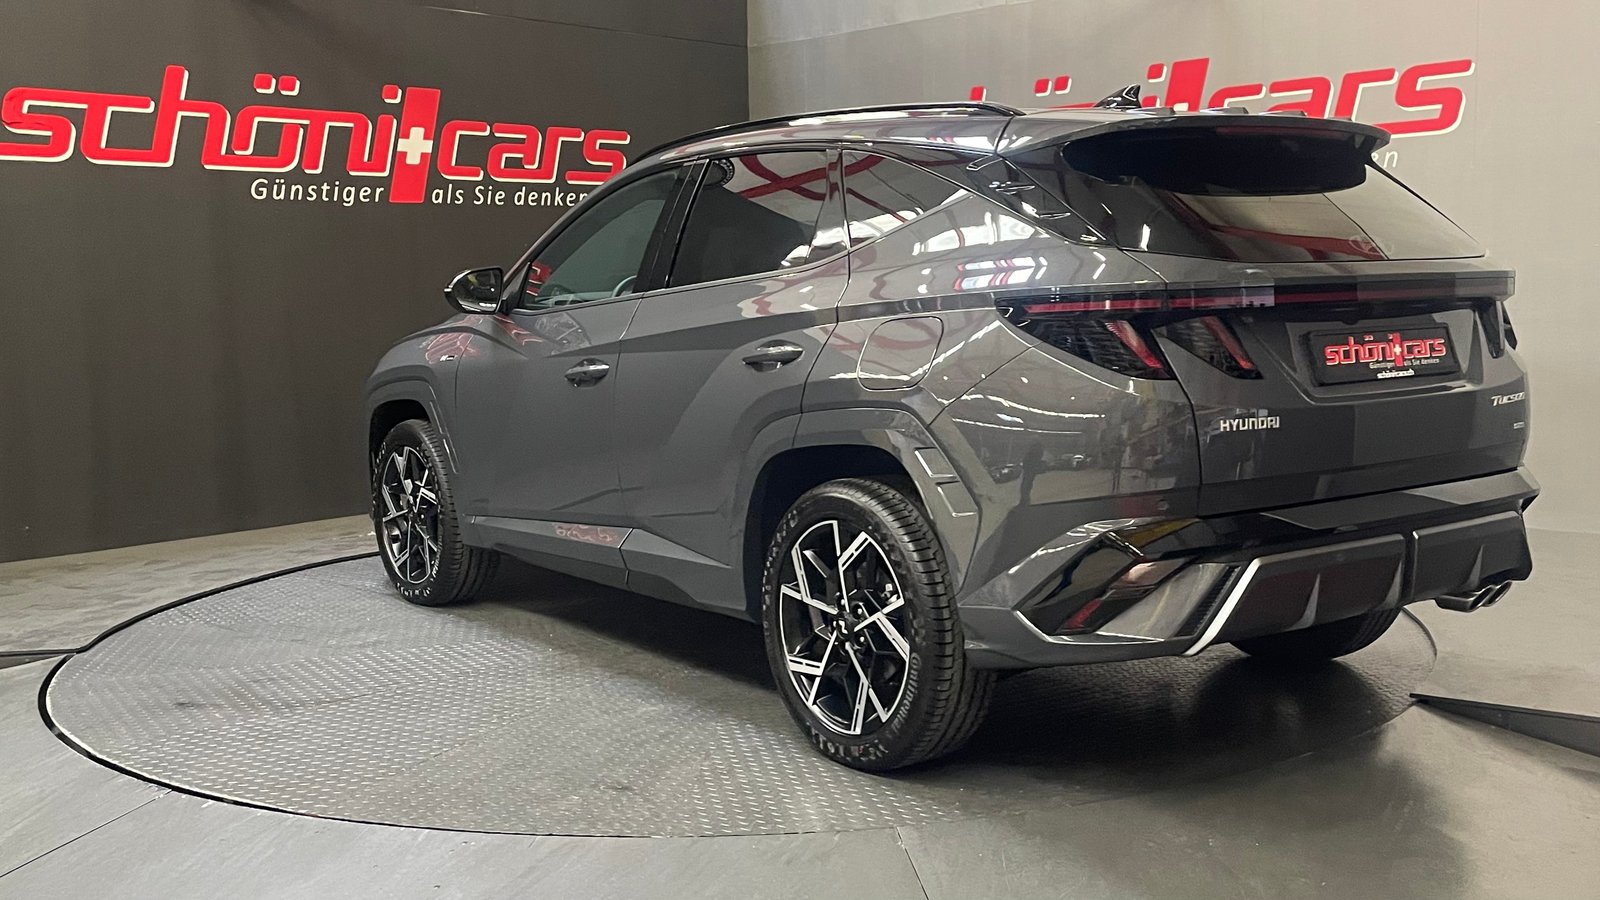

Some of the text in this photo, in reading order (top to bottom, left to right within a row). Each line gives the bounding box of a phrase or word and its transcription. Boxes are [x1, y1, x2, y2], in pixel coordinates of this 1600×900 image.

[250, 178, 384, 207] Günstiger
[432, 185, 465, 205] als
[473, 185, 506, 206] Sie
[1220, 416, 1280, 432] HYUNDAI
